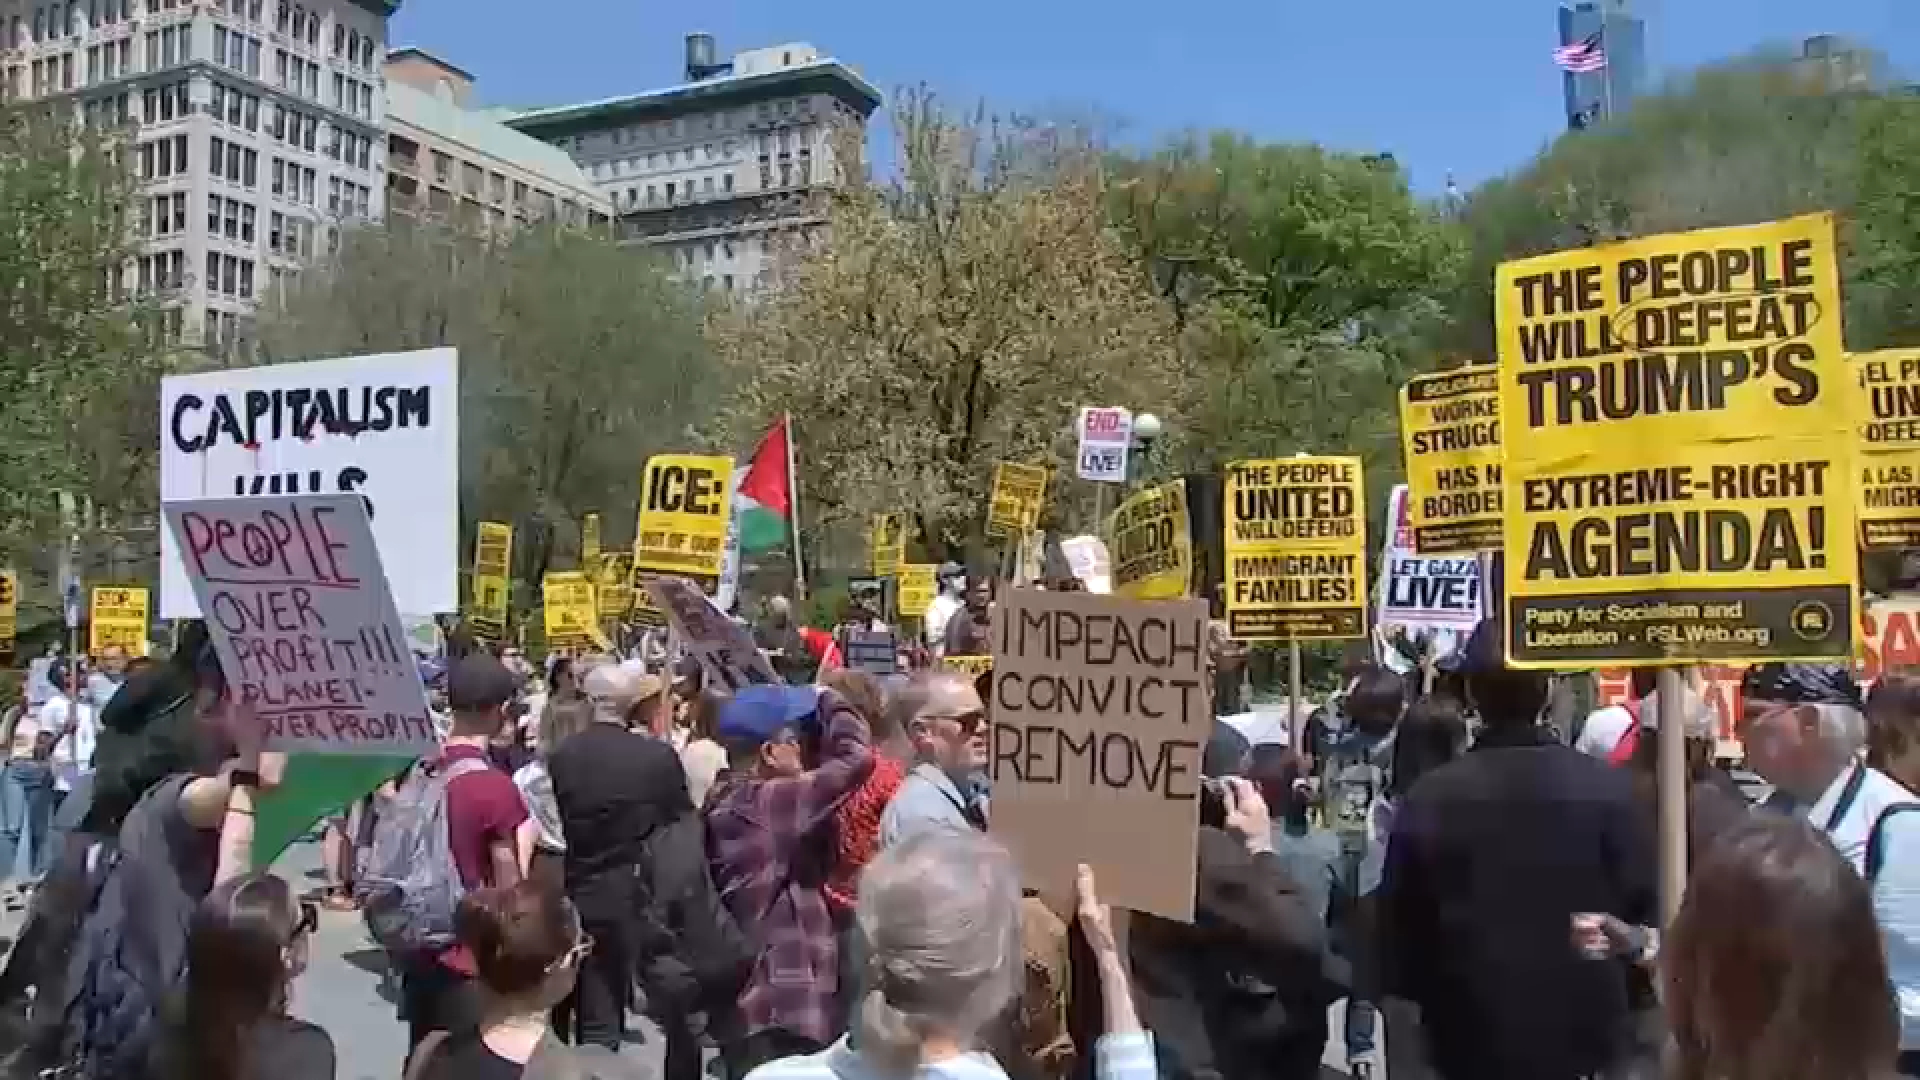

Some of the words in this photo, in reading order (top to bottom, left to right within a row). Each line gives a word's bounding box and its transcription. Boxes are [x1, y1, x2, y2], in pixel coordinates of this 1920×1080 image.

[1514, 265, 1604, 318] THE
[1617, 239, 1815, 304] PEOPLE
[1519, 314, 1625, 364] WILL
[1635, 293, 1816, 350] DEFEAT
[1516, 343, 1821, 429] TRUMP'S
[1871, 384, 1920, 419] UN
[171, 384, 431, 454] CAPITALISM
[1431, 398, 1499, 423] WORKE
[1865, 422, 1920, 442] DEFE
[647, 465, 723, 515] ICE:
[1233, 464, 1273, 487] THE
[1277, 462, 1354, 484] PEOPLE
[1436, 465, 1479, 491] HAS
[1486, 463, 1502, 485] N
[1523, 460, 1831, 513] EXTREME-RIGHT
[1235, 486, 1355, 521] UNITED
[1863, 486, 1920, 507] MIGR
[1234, 520, 1280, 542] WILL
[1283, 519, 1356, 540] DEFEND
[1524, 506, 1828, 581] AGENDA!
[1235, 554, 1357, 579] IMMIGRANT
[1390, 558, 1421, 576] LET
[1235, 577, 1356, 603] FAMILIES!
[1387, 576, 1479, 609] LIVE!
[212, 587, 326, 635] OVER
[1525, 607, 1574, 629] Party
[1576, 604, 1603, 624] for
[1607, 602, 1700, 622] Socialism
[1703, 599, 1744, 619] and
[1001, 607, 1202, 673] IMPEACH
[1525, 628, 1620, 647] Liberation
[1645, 624, 1771, 647] PSLWeb.org
[998, 671, 1199, 724] CONVICT
[993, 722, 1199, 800] REMOVE
